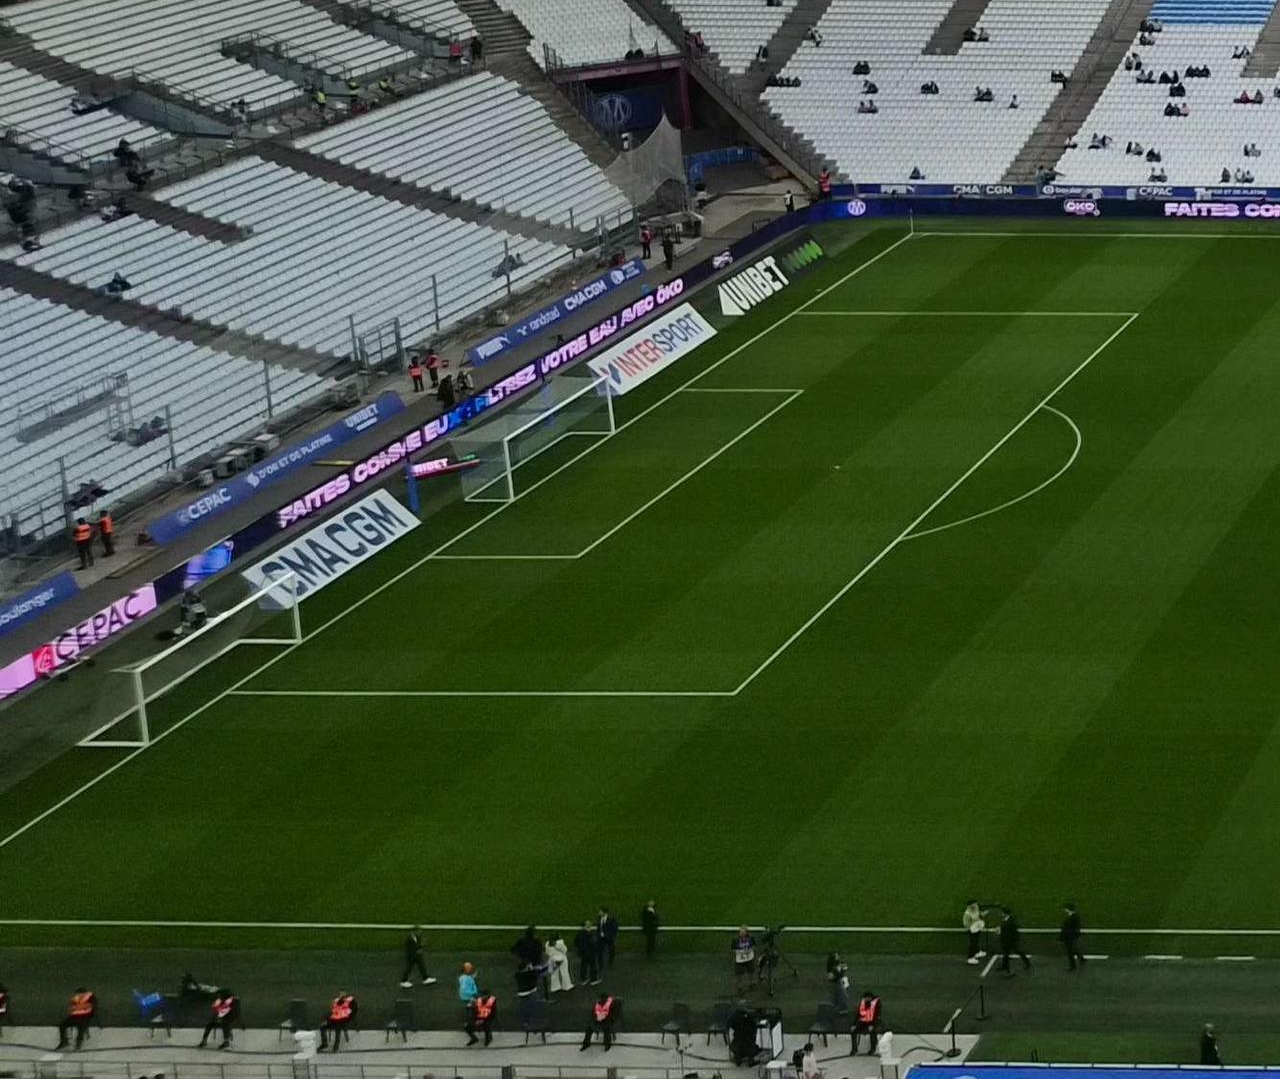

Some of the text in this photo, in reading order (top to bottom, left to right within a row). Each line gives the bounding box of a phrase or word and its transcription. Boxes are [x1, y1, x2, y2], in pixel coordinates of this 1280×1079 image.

[953, 185, 1013, 194] CMA CGM
[1164, 203, 1239, 217] FAITES
[722, 256, 789, 311] UNIBET
[541, 335, 589, 374] VOTRE
[589, 315, 619, 350] EAU
[620, 294, 655, 327] AVEC
[656, 276, 684, 303] ÖKO
[617, 312, 705, 377] INTERSPORT
[344, 403, 379, 428] UNIBET
[188, 487, 232, 521] CEPAC
[326, 498, 408, 558] CGM
[0, 586, 56, 625] oulanger
[55, 594, 142, 661] CEPAC
